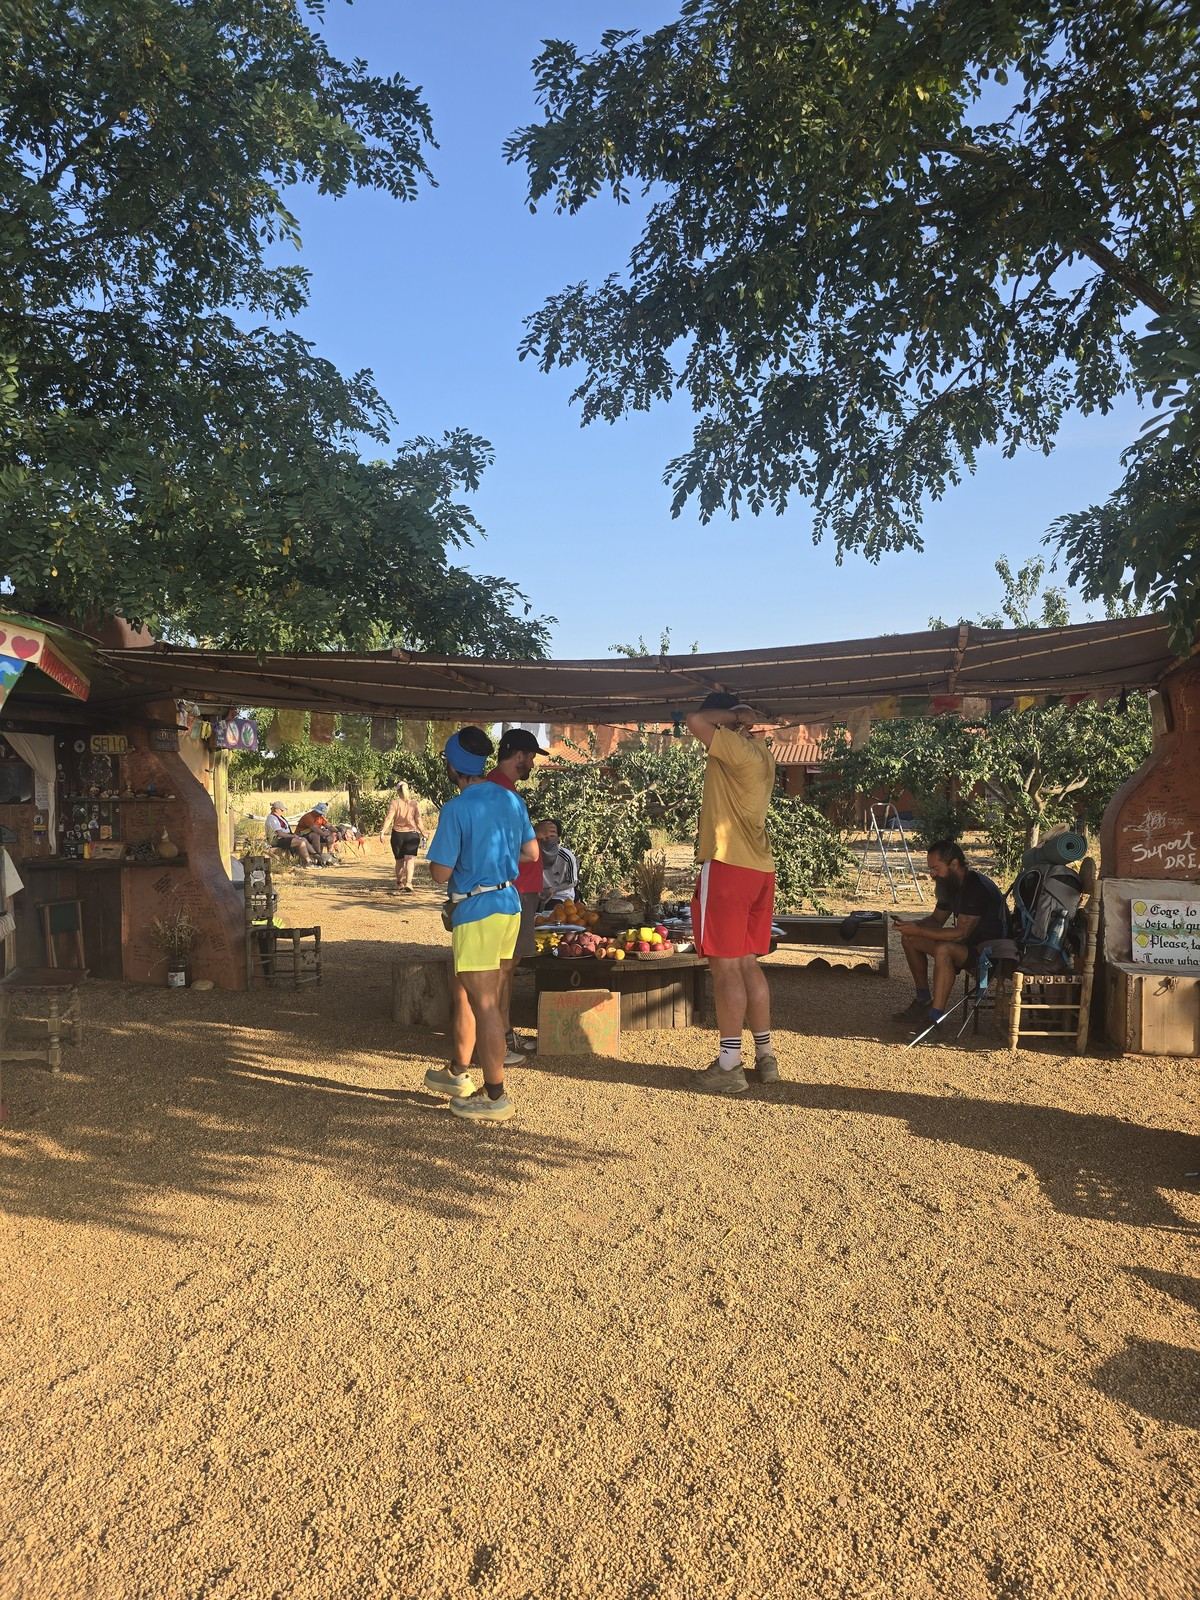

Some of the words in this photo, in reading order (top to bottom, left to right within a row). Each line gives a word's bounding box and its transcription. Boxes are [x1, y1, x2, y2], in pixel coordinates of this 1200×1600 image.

[1164, 853, 1200, 870] DRE
[1150, 904, 1179, 918] Coge
[1186, 906, 1197, 916] lo
[1145, 917, 1168, 930] deja
[1172, 919, 1182, 929] lo
[1150, 934, 1189, 950] Please,
[1143, 953, 1174, 964] Leave
[1178, 956, 1200, 965] wha
